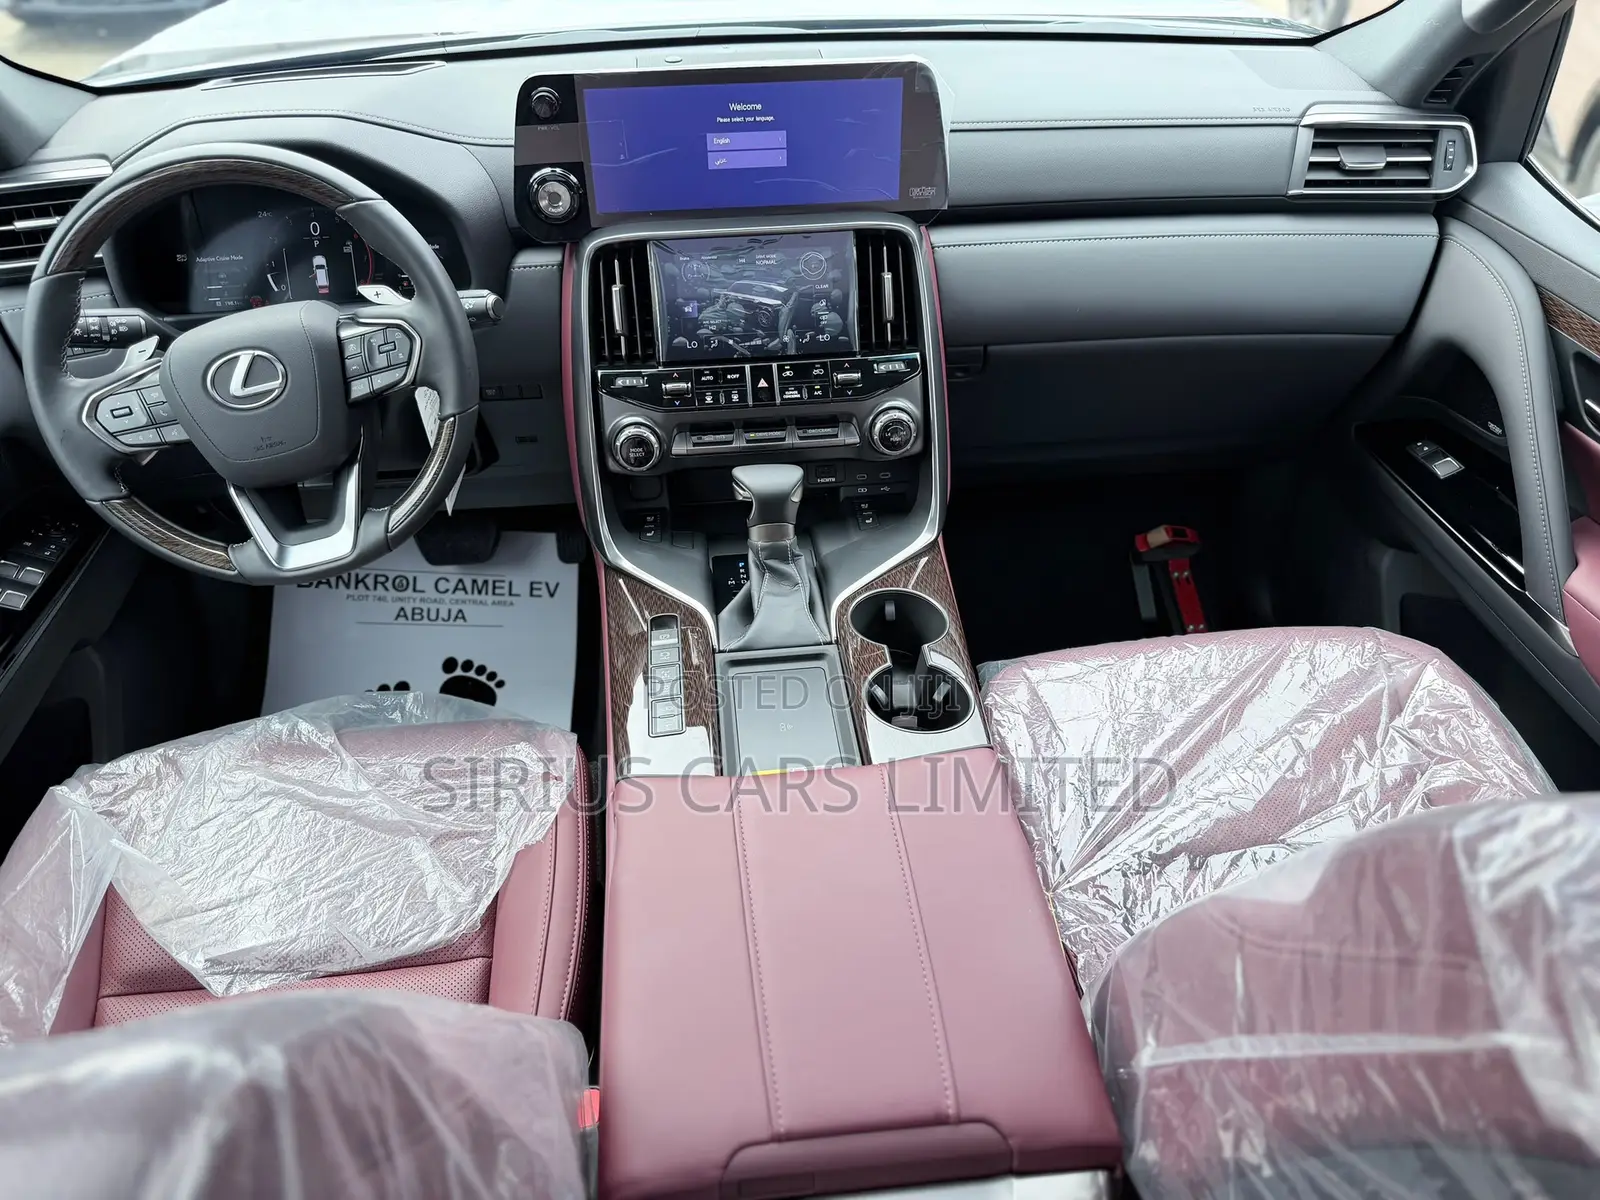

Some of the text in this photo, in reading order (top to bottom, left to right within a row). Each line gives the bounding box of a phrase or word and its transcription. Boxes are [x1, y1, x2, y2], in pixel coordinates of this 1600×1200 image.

[728, 102, 763, 111] Welcome
[713, 137, 731, 145] English
[310, 221, 321, 236] 0
[313, 240, 320, 248] P
[819, 334, 831, 342] LO
[686, 340, 699, 349] LO
[434, 576, 522, 598] CAMEL
[529, 581, 560, 599] EV
[346, 593, 369, 602] PLOT
[391, 596, 417, 604] UNITY
[448, 598, 489, 607] CENTRAL
[491, 600, 515, 608] AREA
[394, 606, 468, 623] ABUJA
